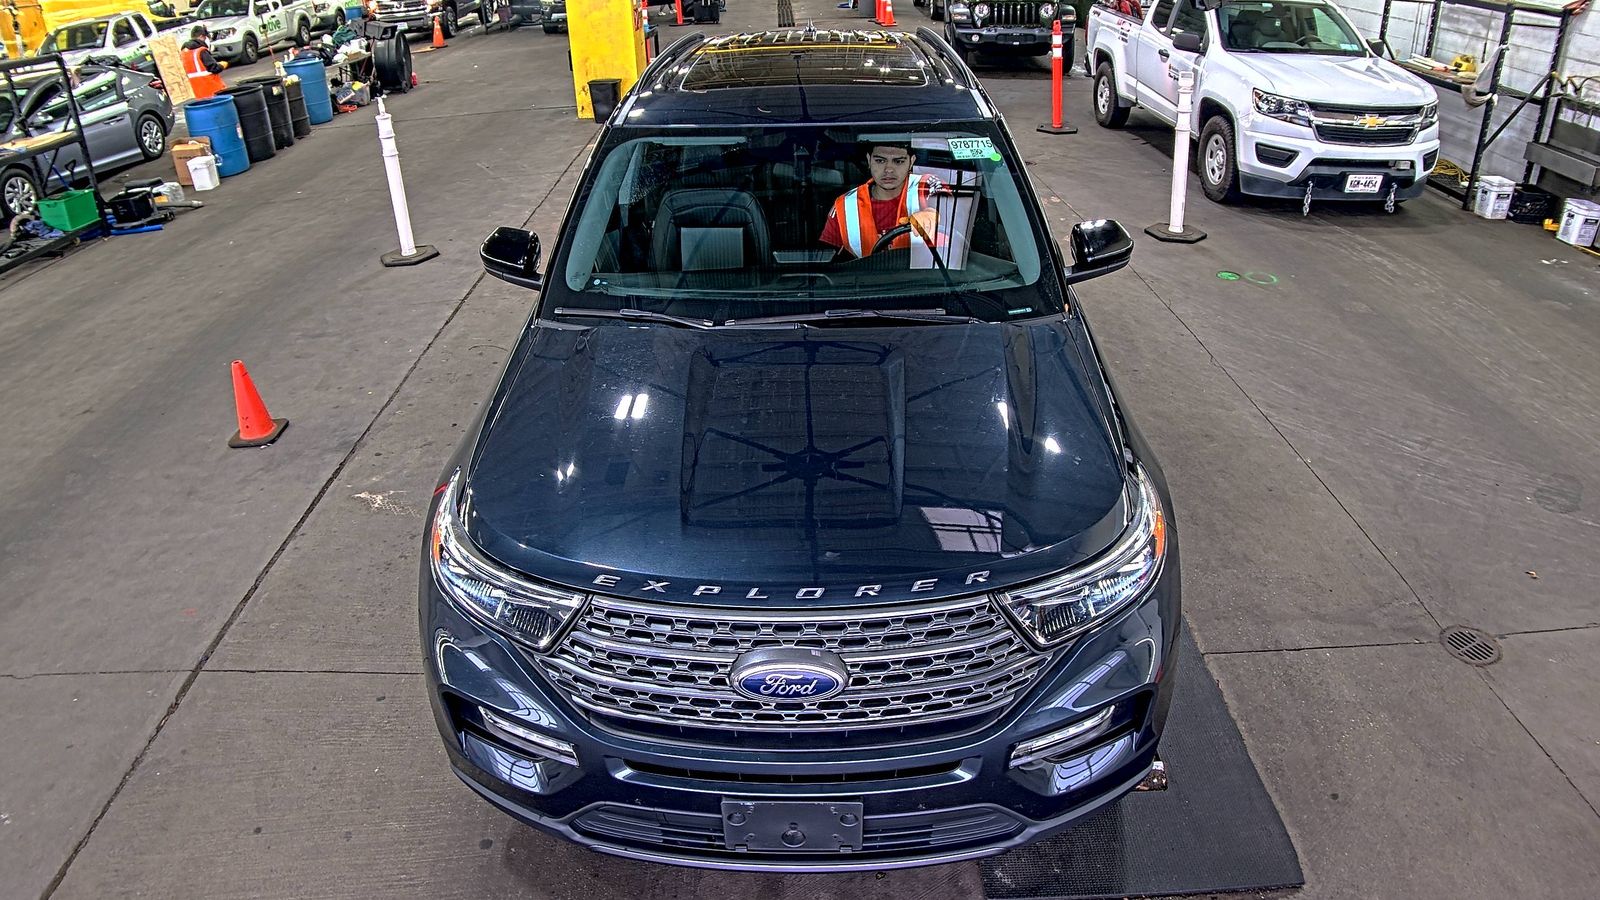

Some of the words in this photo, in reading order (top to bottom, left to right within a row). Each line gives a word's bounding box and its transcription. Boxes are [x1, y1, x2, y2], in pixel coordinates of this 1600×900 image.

[951, 140, 993, 149] 9787715
[593, 570, 990, 599] EXPLORER
[760, 674, 818, 695] Ford
